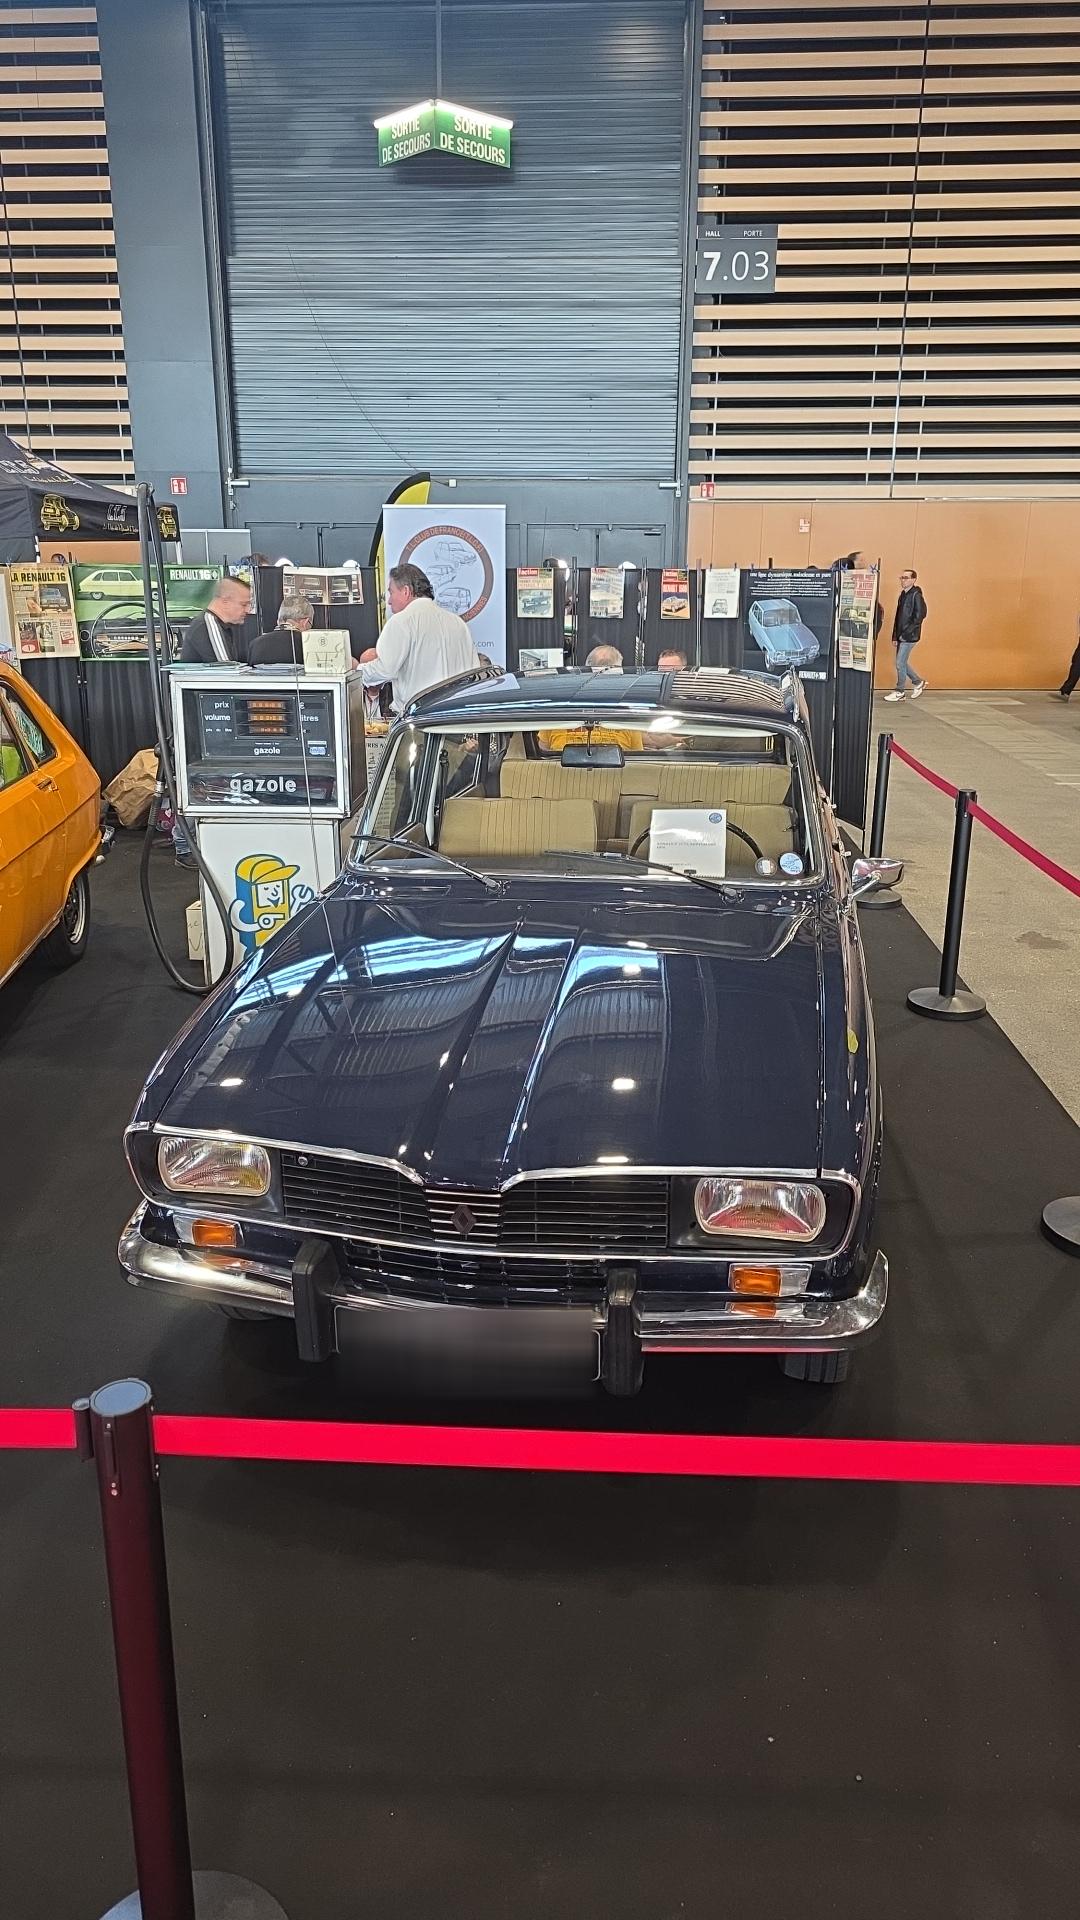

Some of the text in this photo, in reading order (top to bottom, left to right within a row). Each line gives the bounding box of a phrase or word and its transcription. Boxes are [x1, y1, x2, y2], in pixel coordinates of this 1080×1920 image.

[391, 117, 420, 140] SORTIE
[454, 114, 493, 141] SORTIE
[382, 132, 431, 164] DE SECOURS
[440, 133, 506, 165] DE SECOURS
[703, 250, 769, 281] 7.03
[11, 572, 66, 582] LA RENAULT 16
[170, 569, 199, 581] RENAULT
[214, 701, 230, 710] prix
[204, 713, 319, 722] volume itres
[253, 746, 281, 756] gazole
[229, 776, 297, 794] gazole
